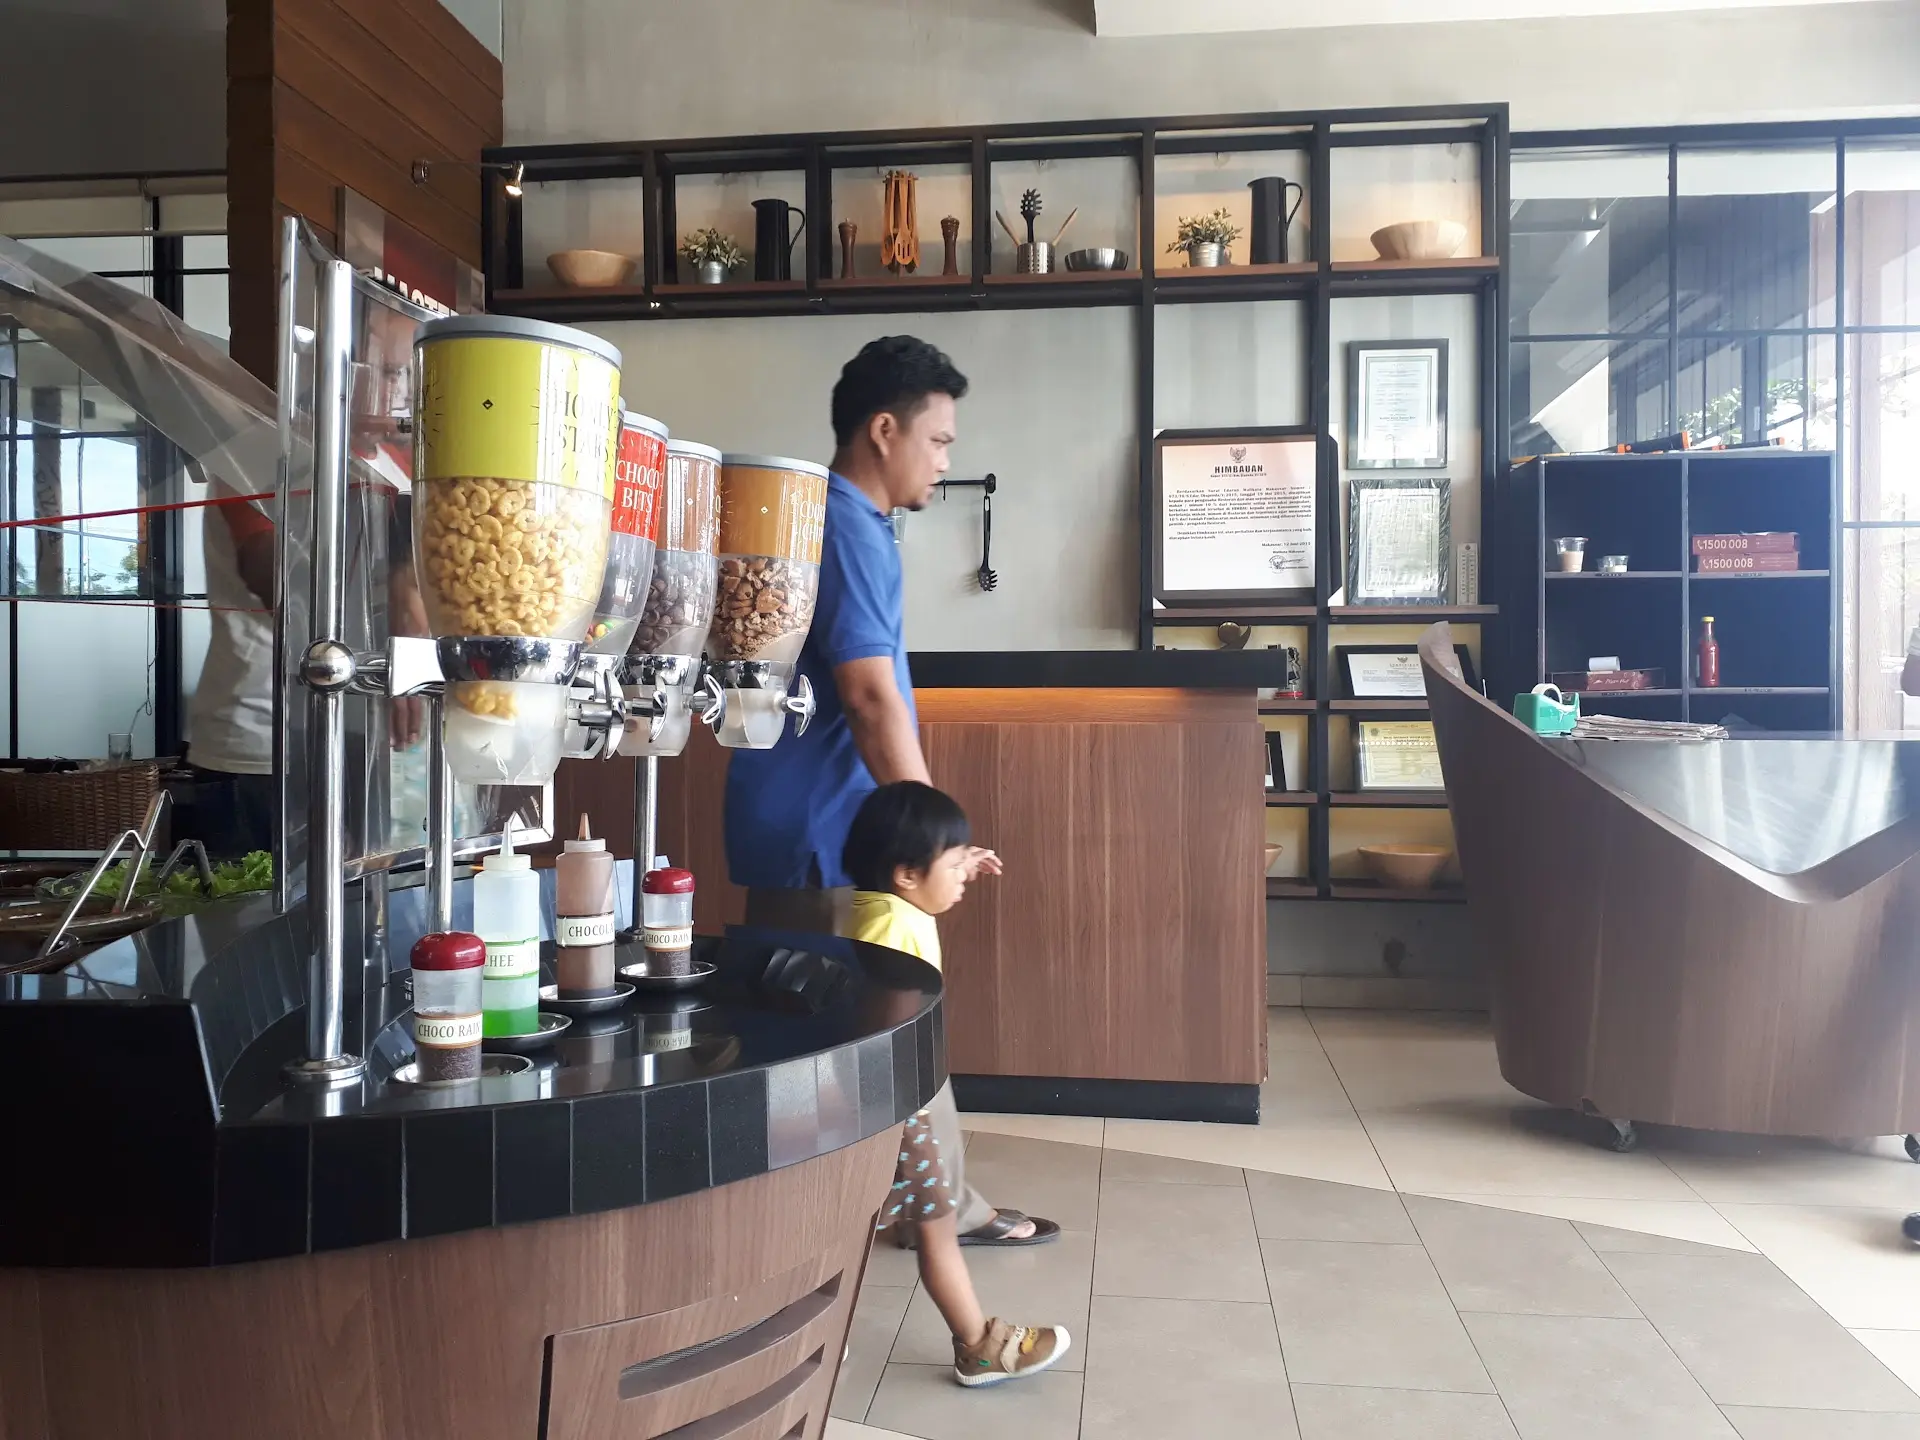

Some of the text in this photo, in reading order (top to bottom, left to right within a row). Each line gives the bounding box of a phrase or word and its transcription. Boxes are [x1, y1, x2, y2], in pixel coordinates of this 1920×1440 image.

[616, 459, 660, 490] CHOCO
[1214, 464, 1263, 474] HIMBAUAN
[622, 487, 653, 513] BITS
[1702, 539, 1727, 549] 1500
[1728, 538, 1748, 549] 008
[1708, 558, 1733, 569] 1500
[1733, 558, 1754, 568] 008
[646, 933, 670, 944] CHOCO
[418, 1023, 455, 1038] CHOCO
